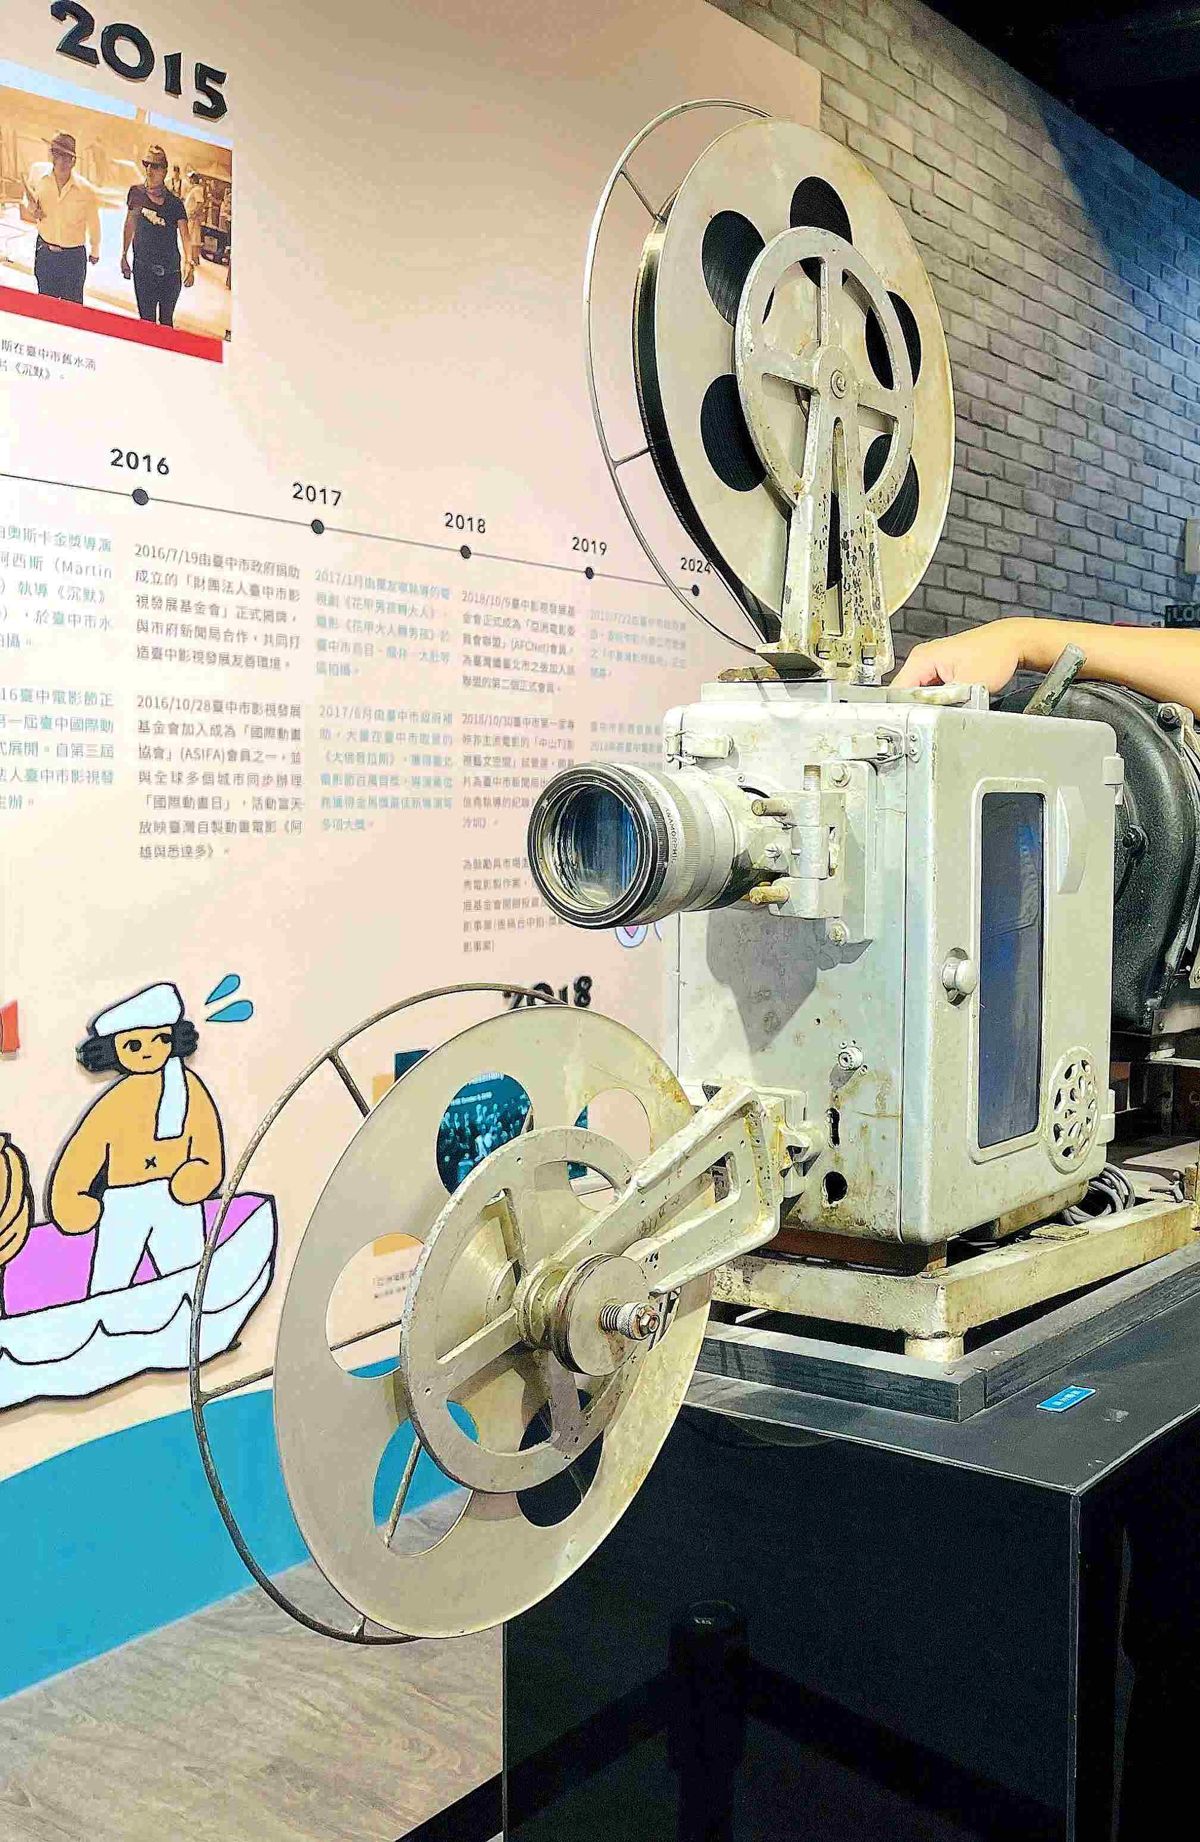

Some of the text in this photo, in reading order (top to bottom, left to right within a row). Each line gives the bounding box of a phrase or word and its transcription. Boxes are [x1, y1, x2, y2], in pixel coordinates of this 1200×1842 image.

[50, 0, 228, 122] 2015
[110, 448, 170, 475] 2016
[292, 482, 342, 506] 2017
[445, 512, 486, 534] 2018
[572, 537, 608, 556] 2019
[680, 557, 712, 575] 2024
